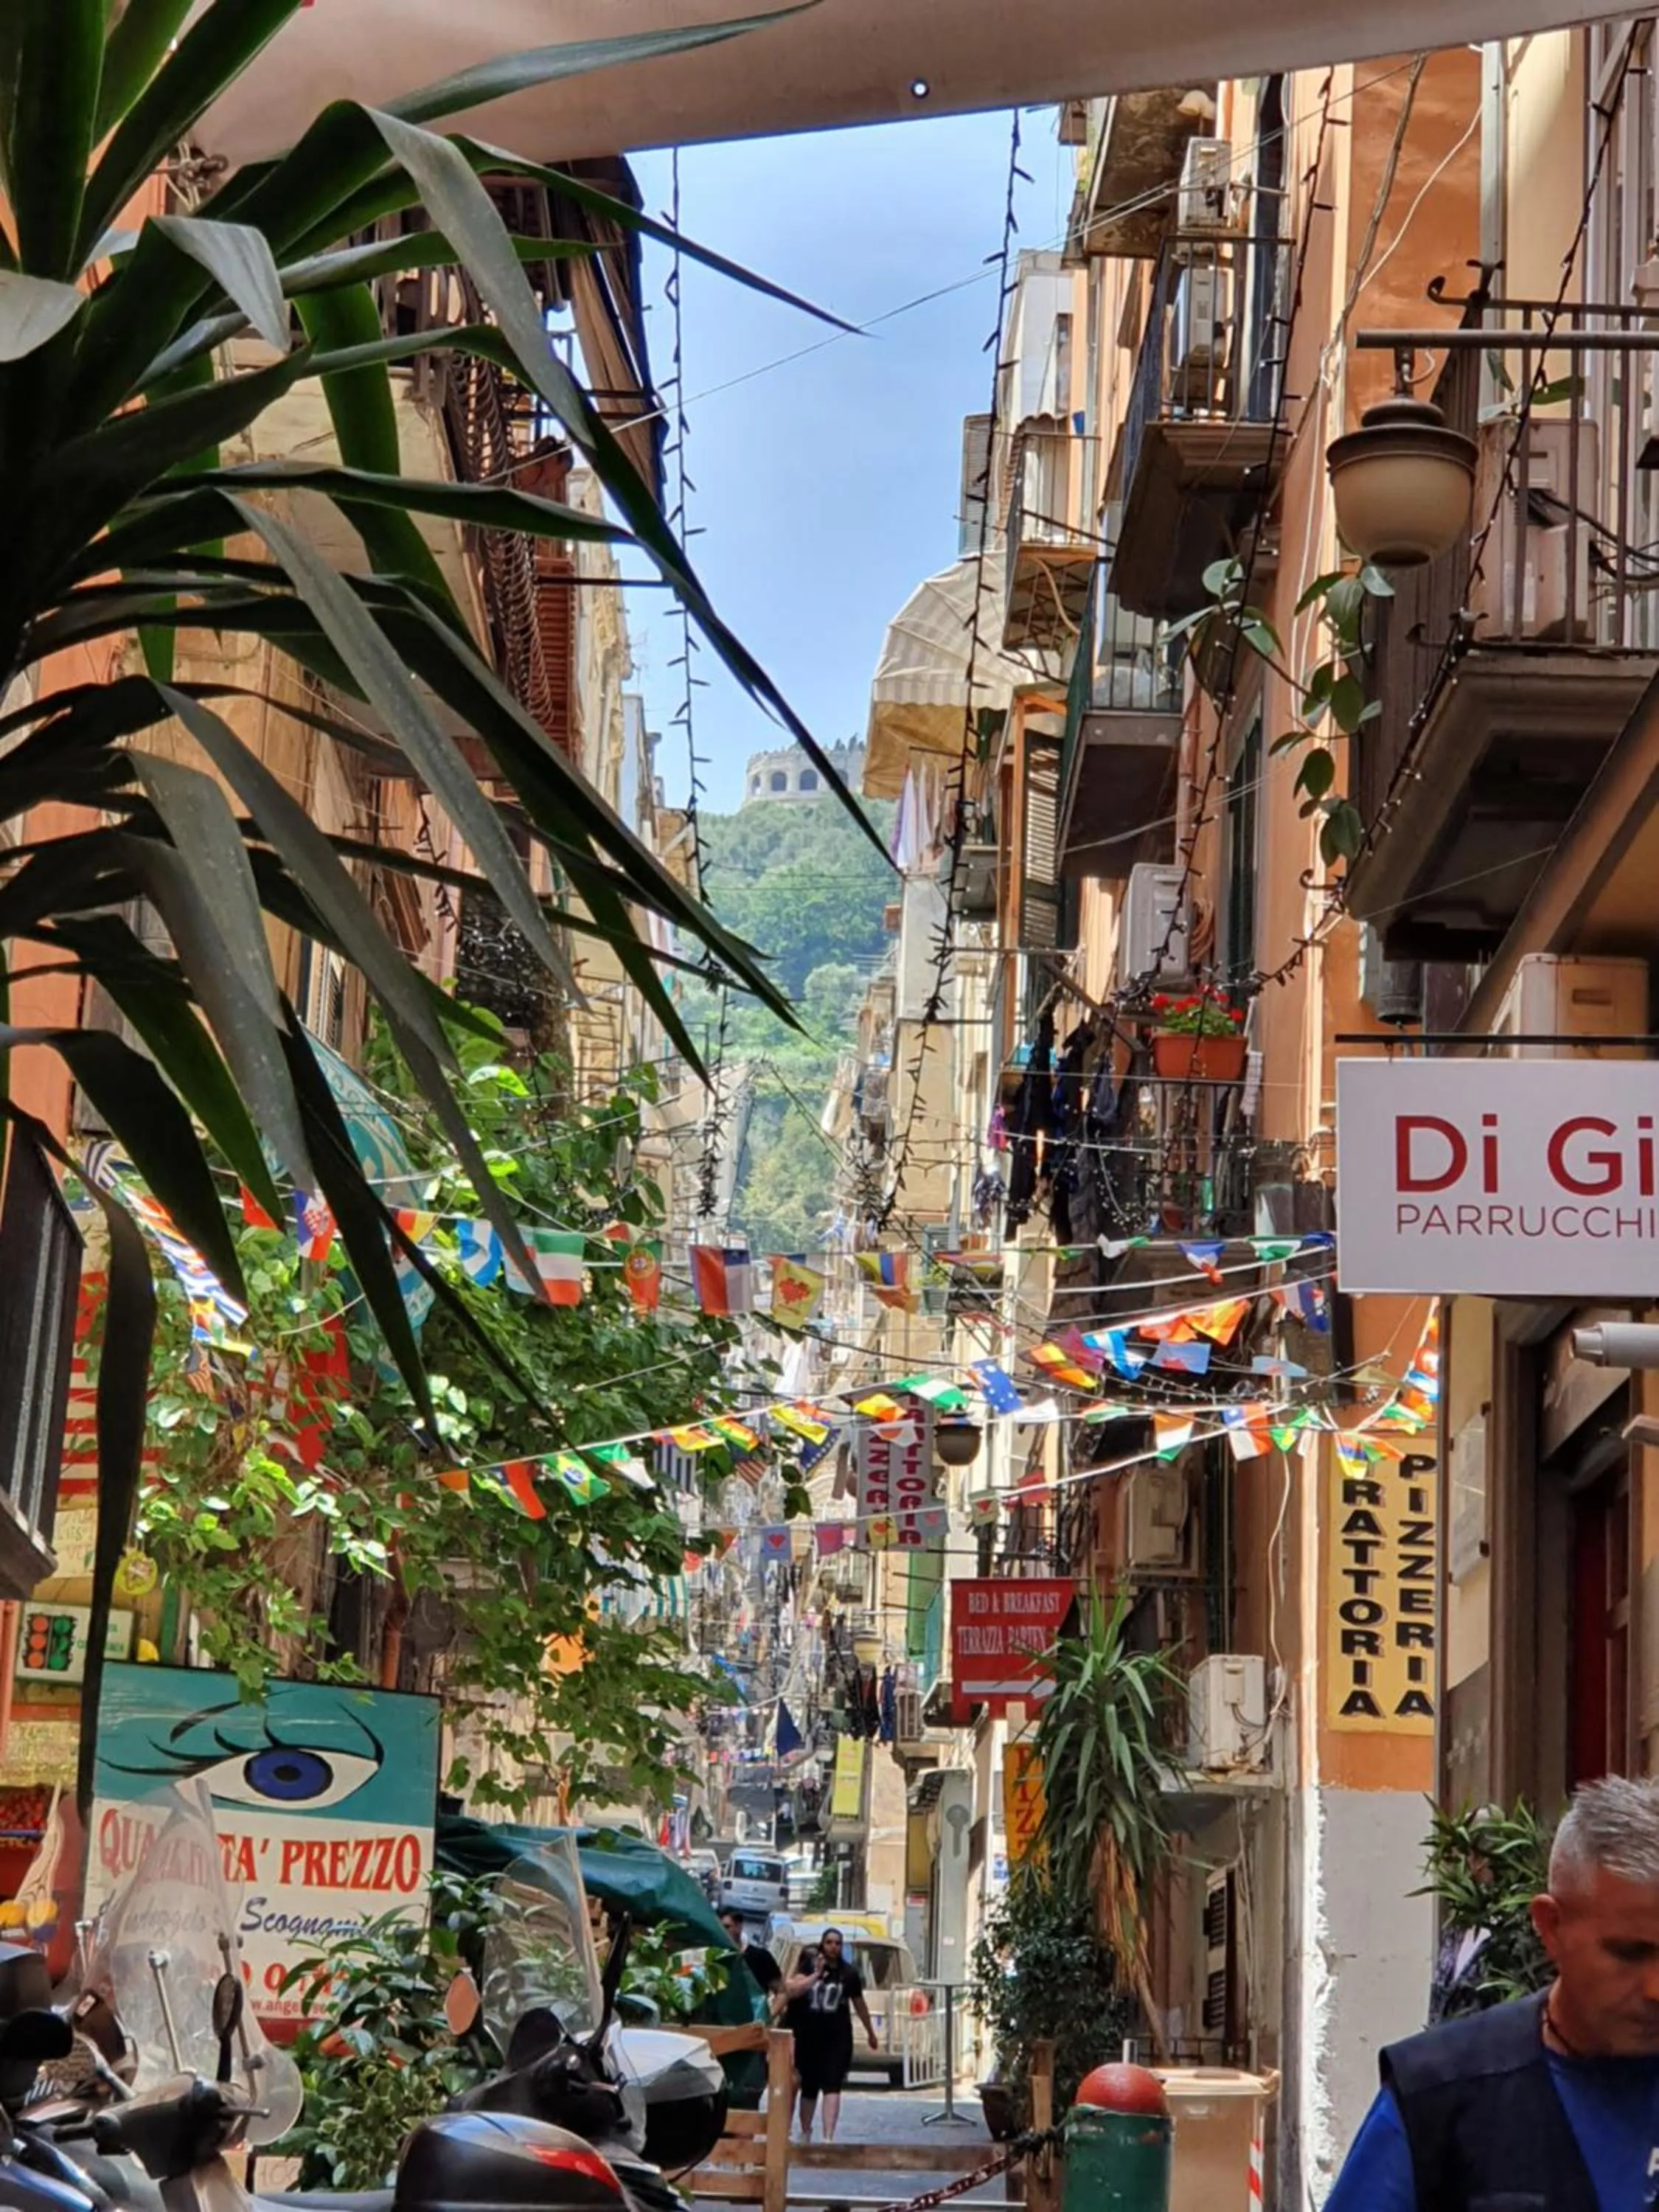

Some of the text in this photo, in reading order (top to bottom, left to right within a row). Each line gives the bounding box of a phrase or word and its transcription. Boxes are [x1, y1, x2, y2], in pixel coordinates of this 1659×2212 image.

[1395, 1113, 1655, 1197] Di Gi
[1397, 1203, 1655, 1239] PARRUCCHI
[968, 1592, 989, 1613] BED
[1004, 1592, 1061, 1613] BREAKFAST
[1339, 1463, 1385, 1719] RATTORIA
[1394, 1454, 1436, 1717] PIZZERIA
[279, 1834, 422, 1893] PREZZO
